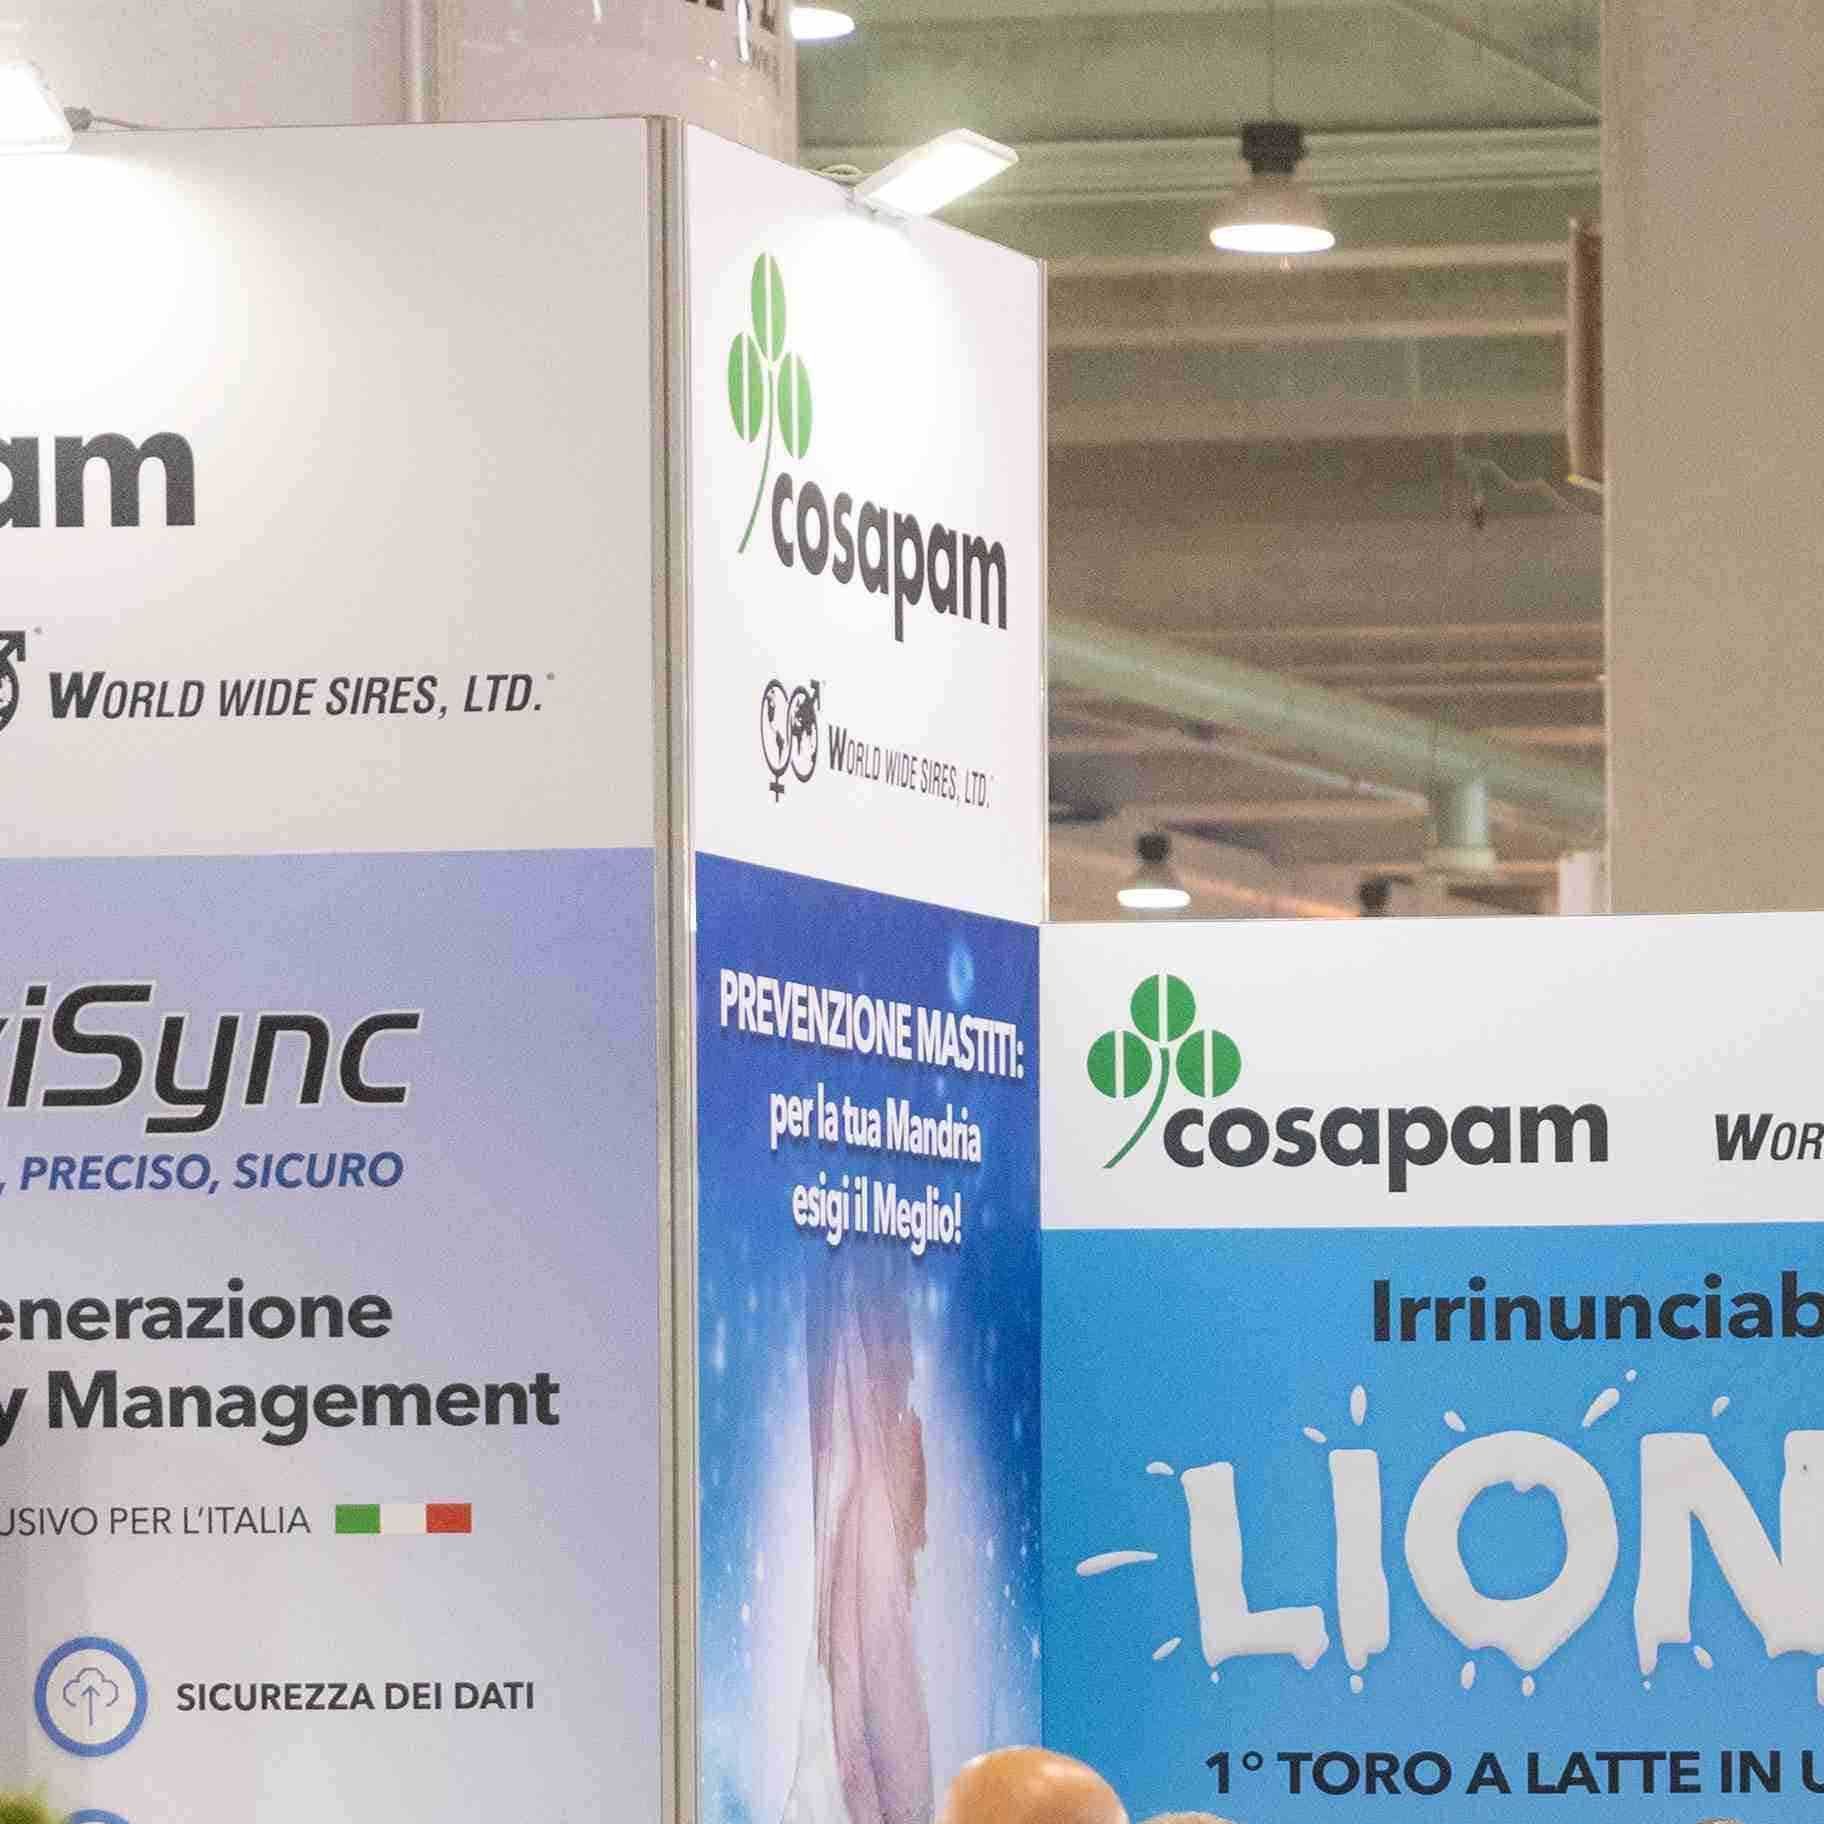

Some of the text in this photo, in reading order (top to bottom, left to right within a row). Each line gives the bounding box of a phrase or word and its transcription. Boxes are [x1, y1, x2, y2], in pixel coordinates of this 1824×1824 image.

[771, 473, 1008, 643] cosapam
[50, 672, 541, 719] WORLD WIDE SIRES, LTD.
[828, 724, 881, 781] WORLD
[885, 749, 918, 791] WIDE
[964, 769, 990, 808] LTD.
[720, 969, 1023, 1079] PREVENZIONE MASTITI:
[771, 1082, 982, 1162] per la tua Mandria
[1163, 1101, 1609, 1193] cosapam
[20, 1152, 403, 1194] PRECISO, SICURO
[792, 1171, 961, 1256] esigi il Meglio!
[48, 1371, 560, 1446] Management
[109, 1506, 172, 1535] PER
[184, 1506, 311, 1534] L'ITALIA
[177, 1682, 533, 1711] SICUREZZA DEI DATI
[1206, 1751, 1263, 1794] 1°
[1277, 1751, 1451, 1795] TORO
[1466, 1752, 1511, 1794] A
[1528, 1751, 1701, 1794] LATTE
[1721, 1751, 1780, 1793] IN
